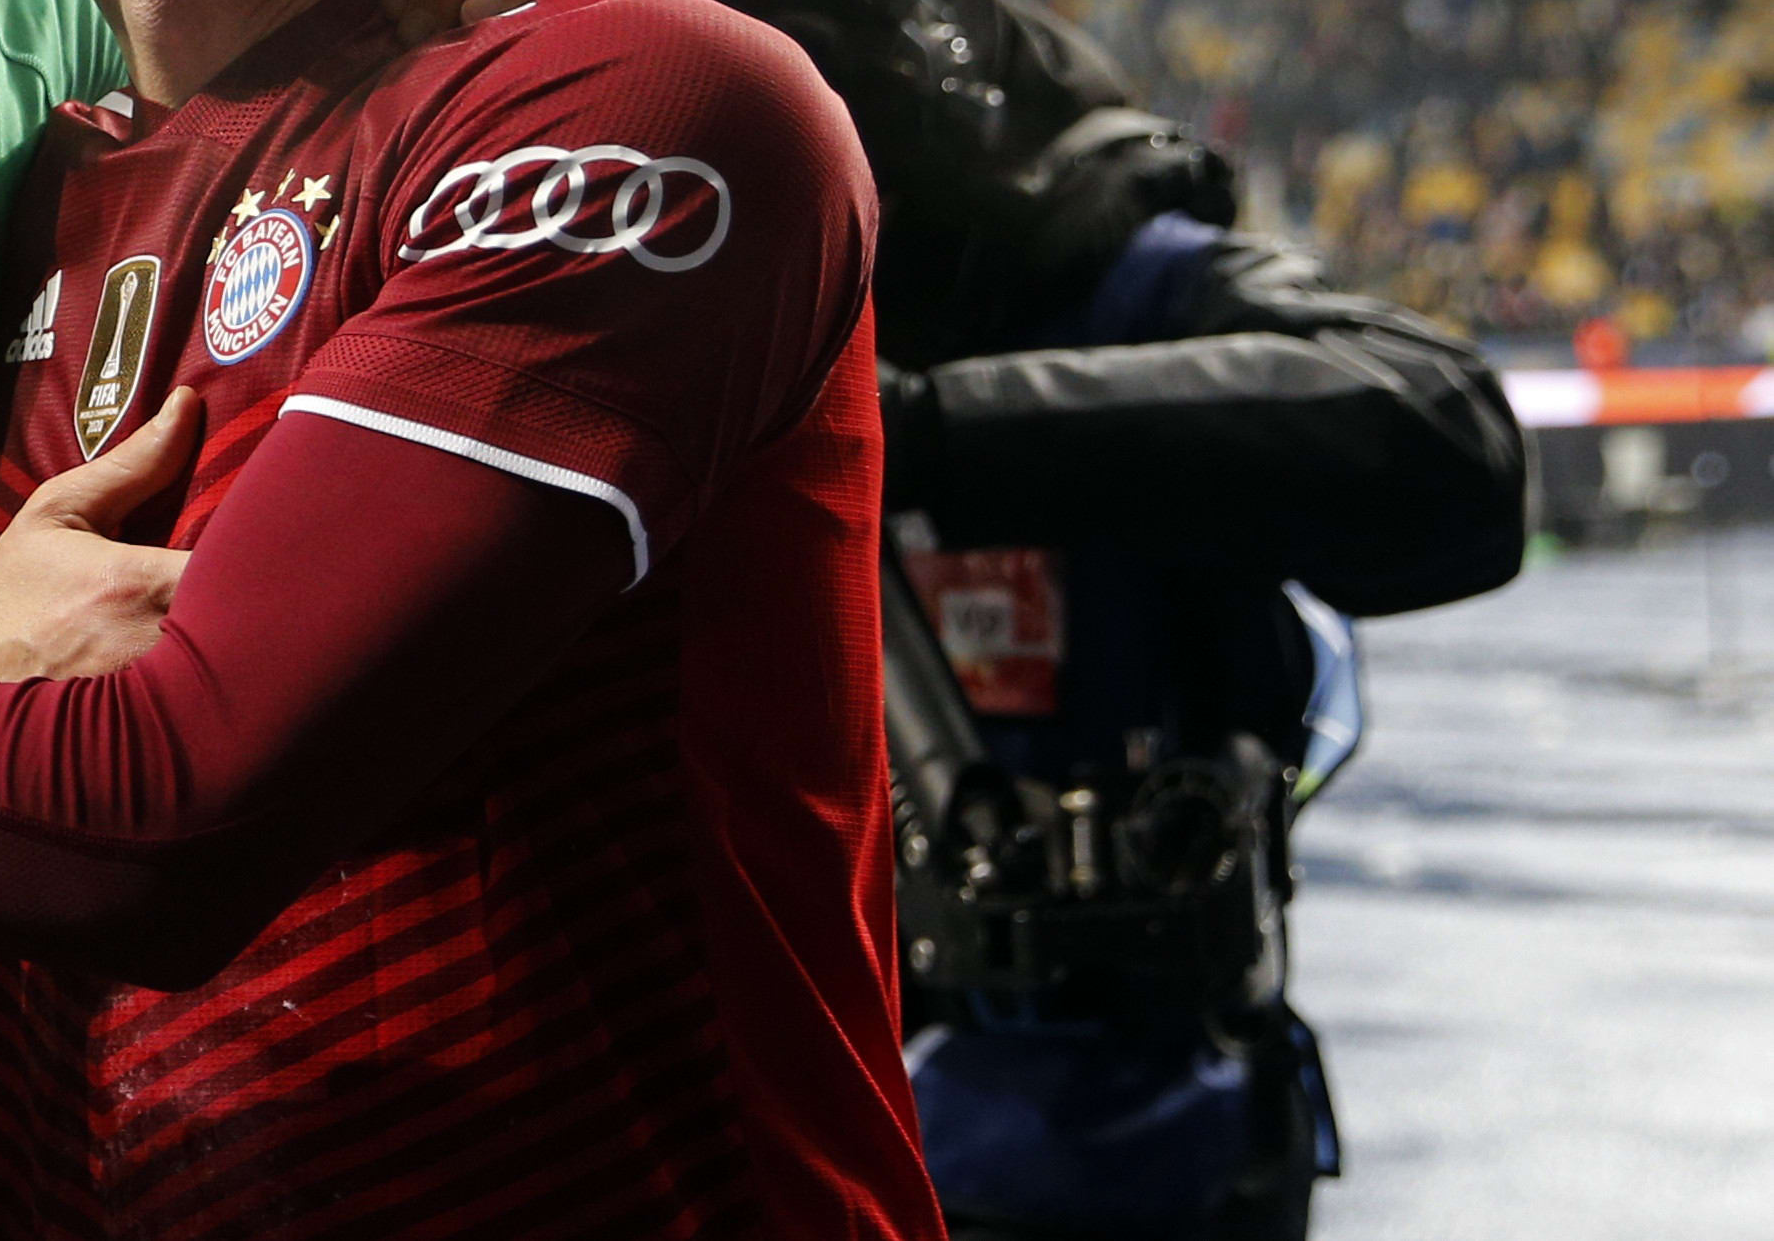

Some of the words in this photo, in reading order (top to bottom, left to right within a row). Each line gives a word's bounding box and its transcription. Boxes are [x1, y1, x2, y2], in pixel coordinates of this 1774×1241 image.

[217, 249, 237, 282] FC
[242, 220, 300, 269] BAYERN
[89, 383, 116, 407] FIFA
